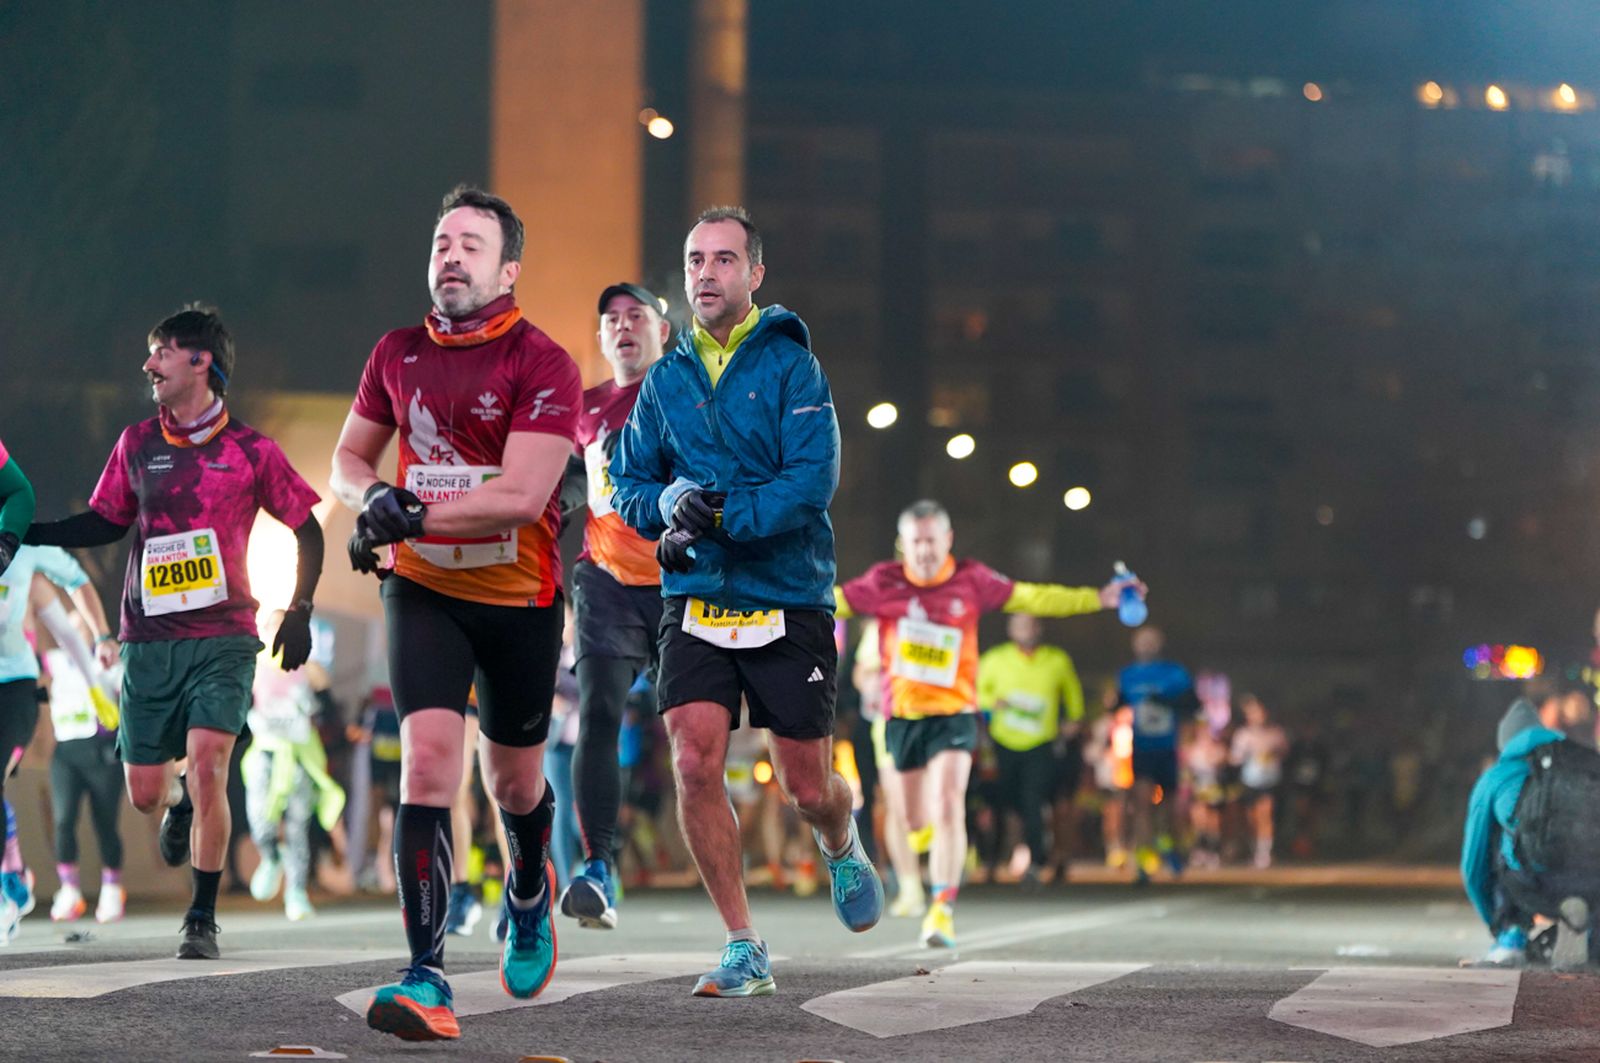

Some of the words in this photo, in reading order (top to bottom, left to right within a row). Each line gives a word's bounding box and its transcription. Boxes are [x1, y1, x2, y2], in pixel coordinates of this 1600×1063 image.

[426, 478, 456, 488] NOCHE
[458, 478, 471, 488] DE
[417, 490, 434, 501] SAN
[153, 543, 175, 553] NOCHE
[177, 542, 186, 550] DE
[149, 557, 213, 588] 12800
